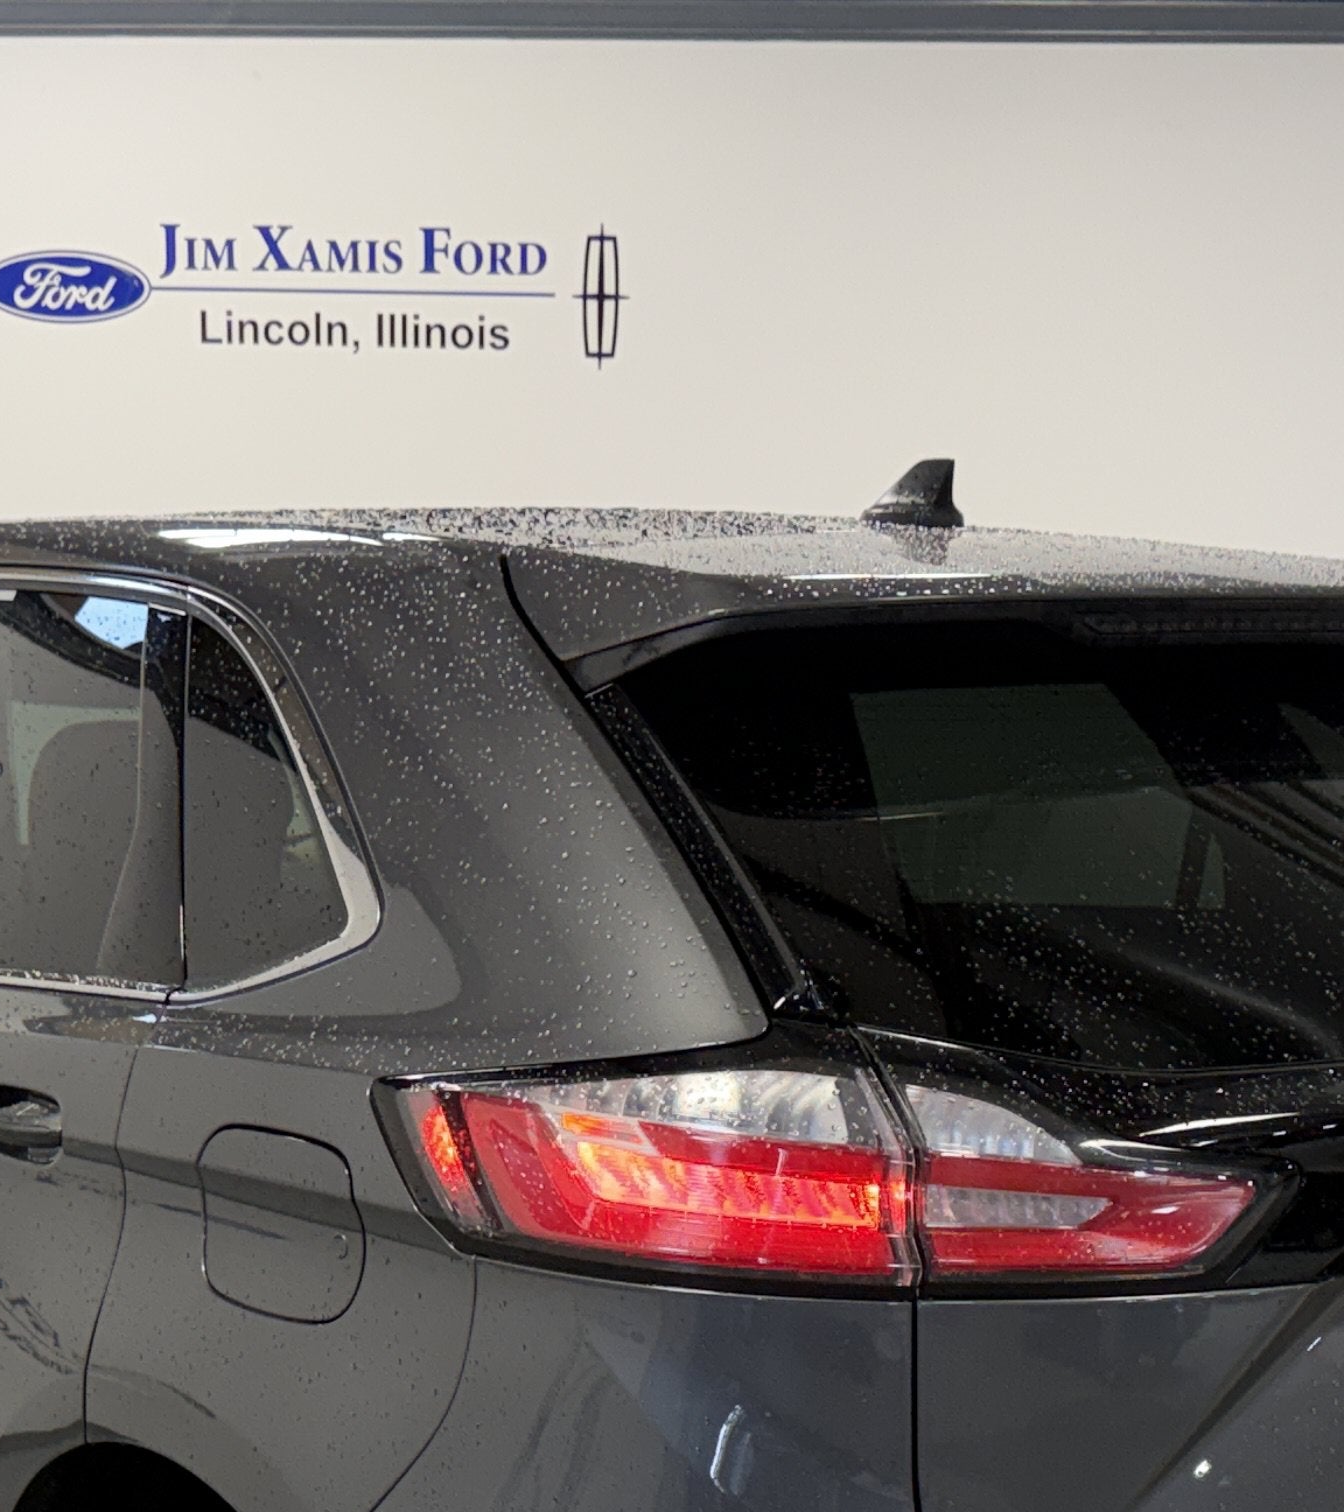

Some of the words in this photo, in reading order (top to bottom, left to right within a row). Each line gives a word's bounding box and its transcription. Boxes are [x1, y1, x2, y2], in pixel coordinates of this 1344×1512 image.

[160, 224, 236, 279] JIM
[253, 225, 403, 274] XAMIS
[420, 227, 547, 276] FORD
[13, 262, 118, 311] Ford
[200, 310, 360, 354] Lincoln,
[377, 313, 511, 351] Illinois
